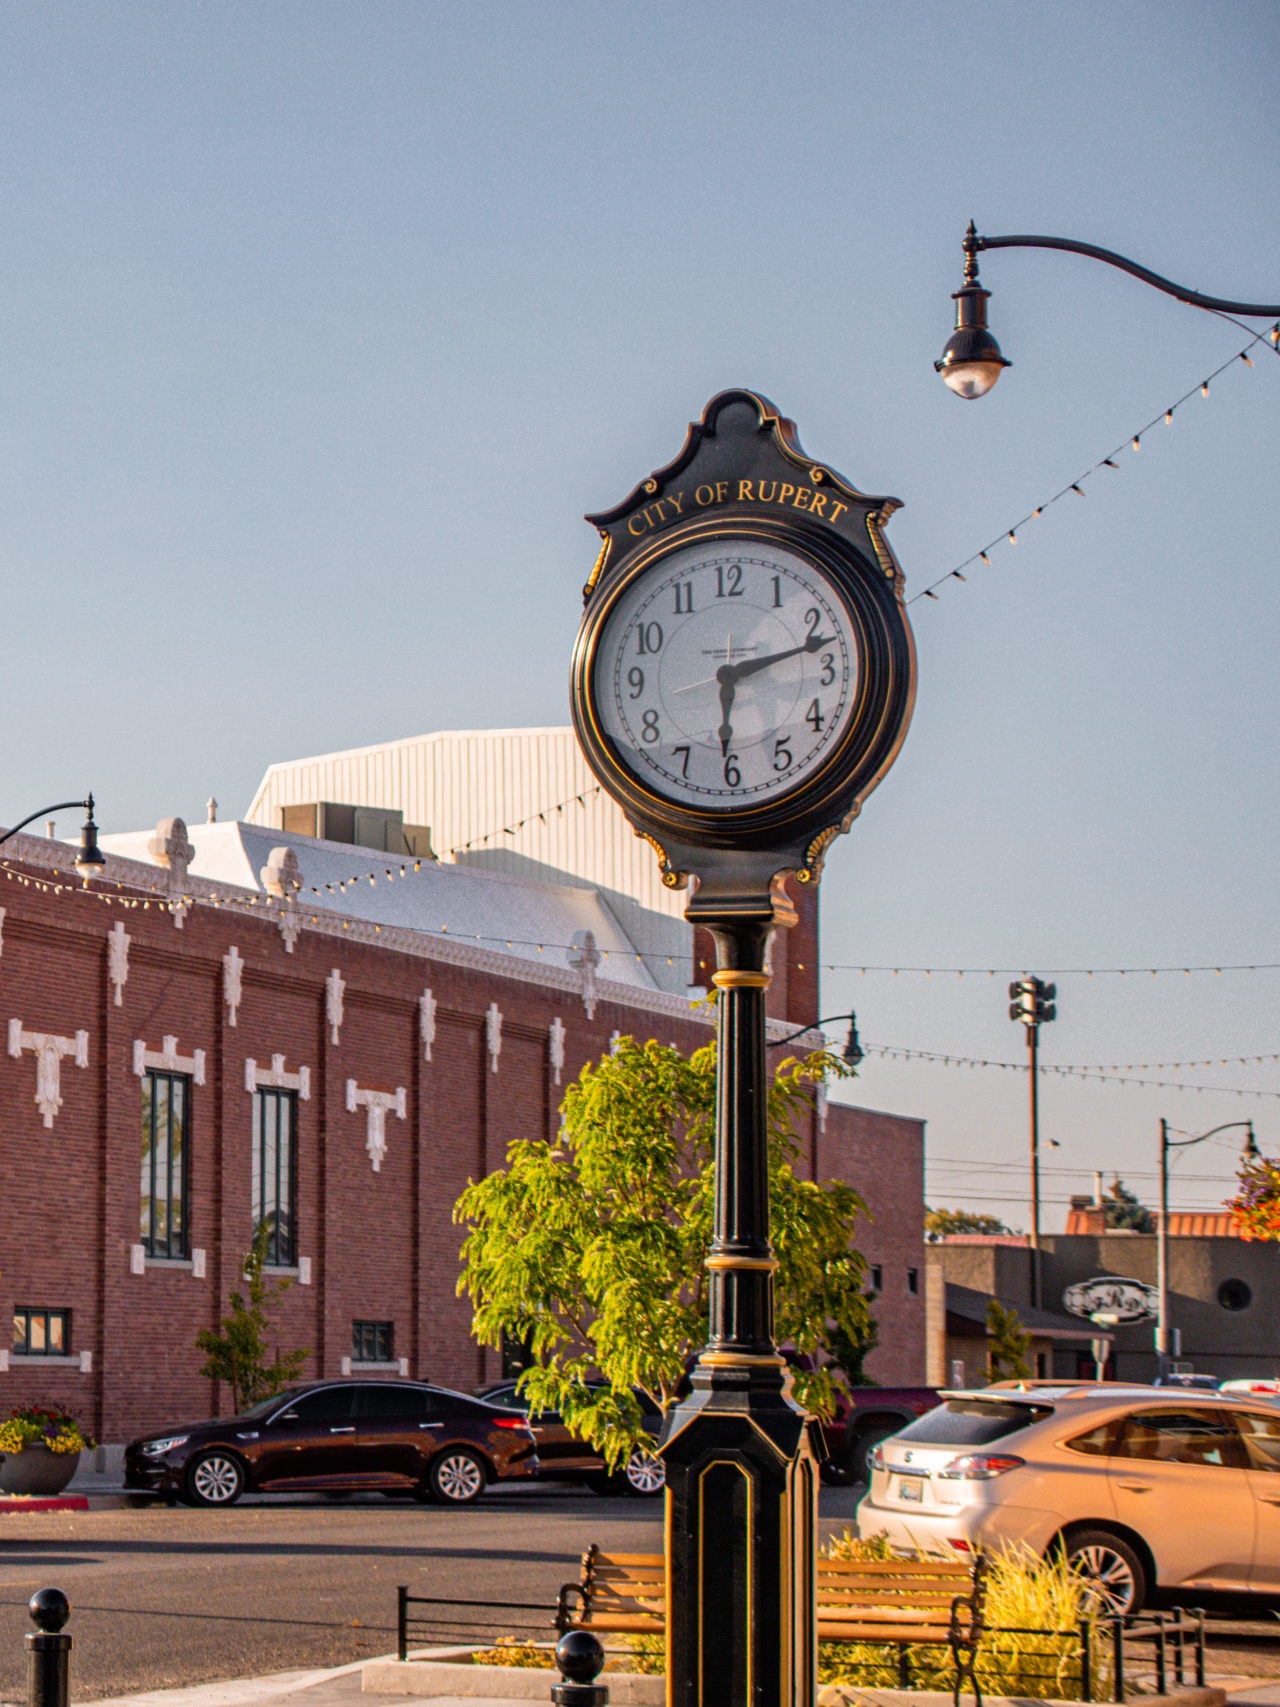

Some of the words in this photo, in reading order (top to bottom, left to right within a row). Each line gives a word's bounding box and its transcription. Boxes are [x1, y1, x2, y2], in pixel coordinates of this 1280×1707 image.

[628, 491, 684, 536] CITY
[695, 481, 729, 506] OF
[737, 479, 849, 524] RUPERT
[672, 580, 696, 615] 11
[714, 564, 746, 599] 12
[771, 575, 784, 609] 1
[635, 621, 664, 655] 10
[804, 607, 823, 642] 2
[627, 666, 645, 699] 9
[820, 652, 837, 686] 3
[641, 709, 660, 744] 8
[805, 698, 825, 733] 4
[671, 745, 691, 780] 7
[723, 754, 741, 788] 6
[773, 735, 793, 772] 5
